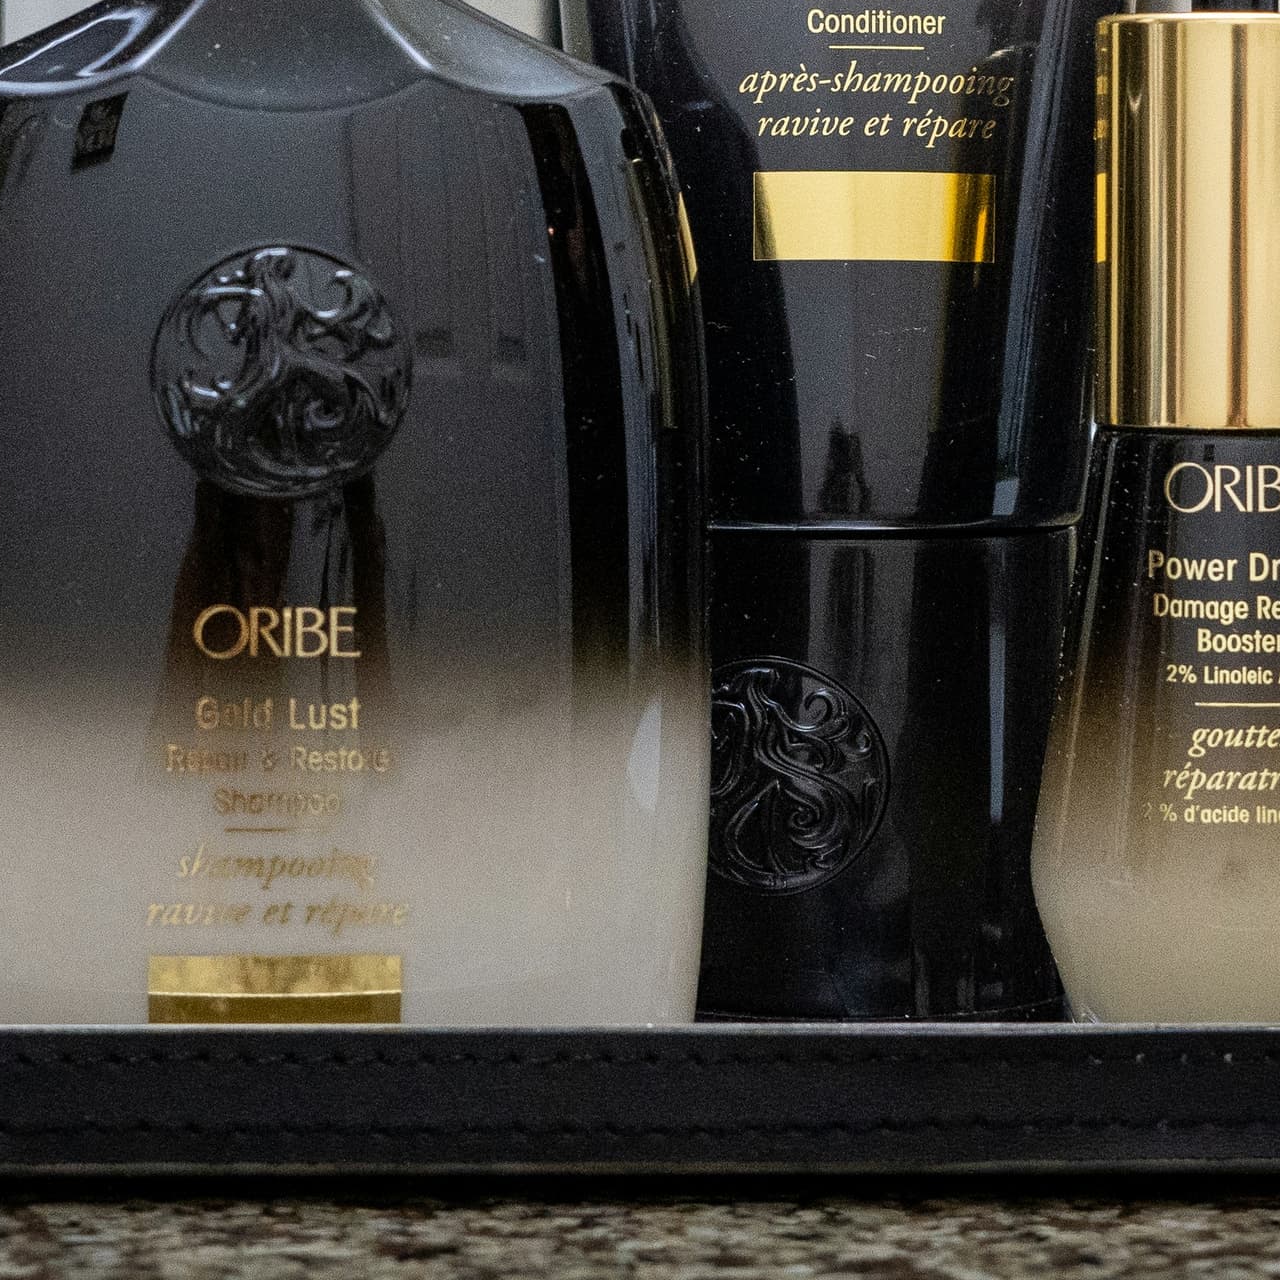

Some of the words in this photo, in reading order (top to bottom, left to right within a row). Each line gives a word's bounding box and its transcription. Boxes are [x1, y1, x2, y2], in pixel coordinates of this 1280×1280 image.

[807, 9, 946, 35] Conditioner
[738, 59, 1014, 107] après-shampooing
[757, 108, 854, 137] ravive
[864, 113, 893, 137] et
[902, 108, 997, 148] répare
[1148, 549, 1238, 582] Power
[1153, 592, 1249, 625] Damage
[193, 603, 363, 659] ORIBE
[1166, 664, 1197, 684] 2%
[1204, 666, 1273, 685] Linoleic
[288, 696, 361, 730] Lust
[1184, 805, 1250, 824] d'acide
